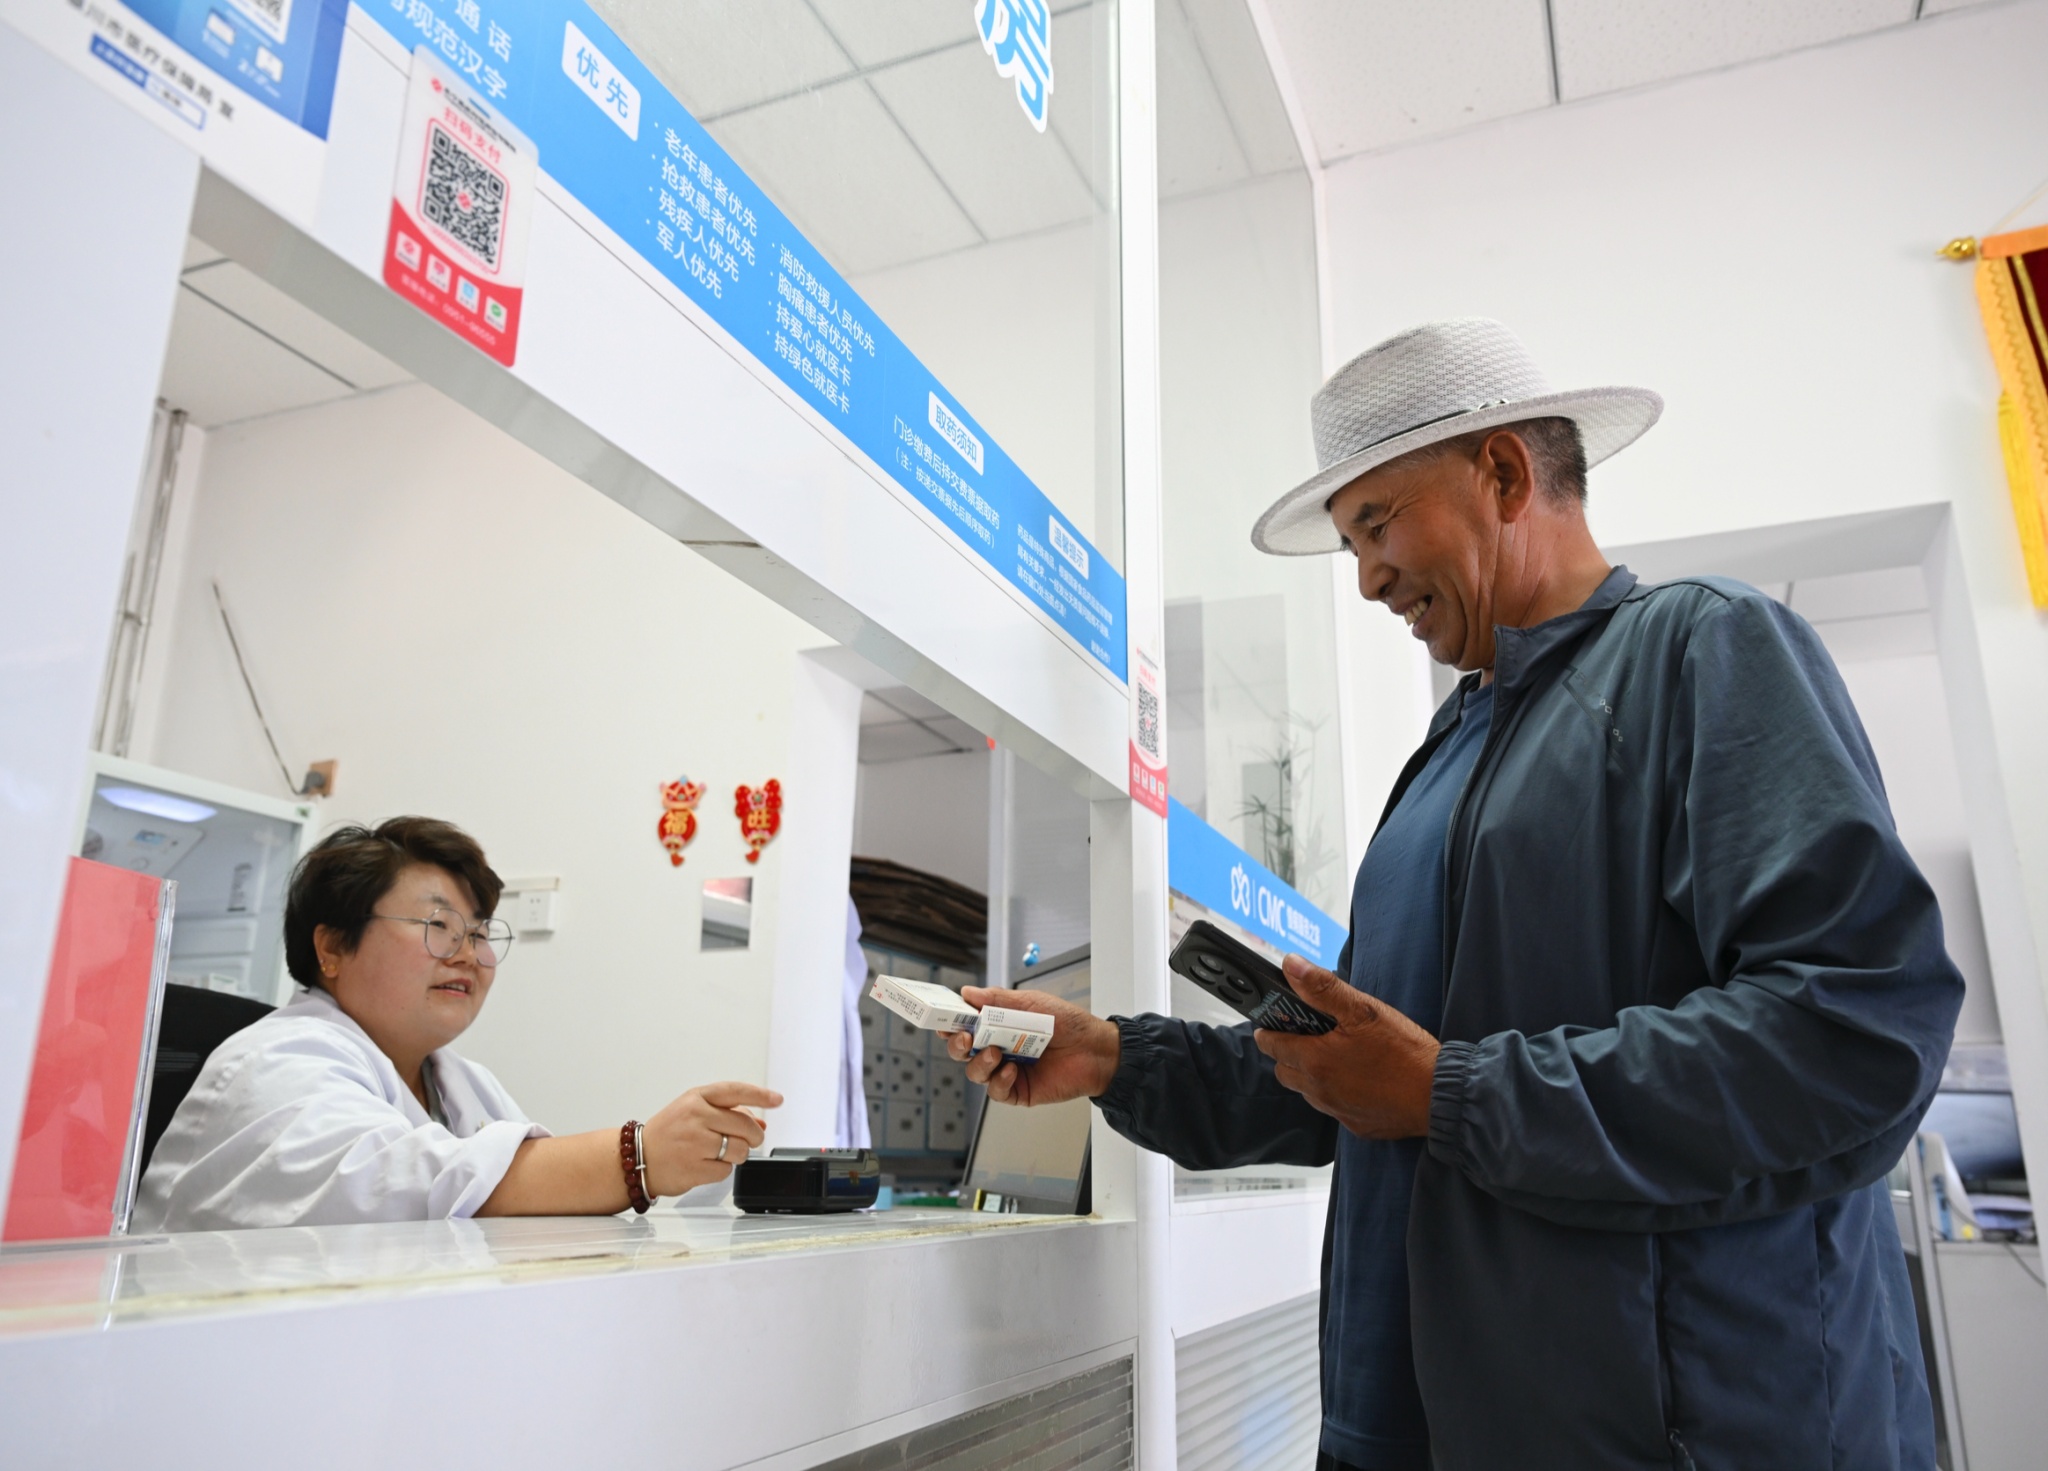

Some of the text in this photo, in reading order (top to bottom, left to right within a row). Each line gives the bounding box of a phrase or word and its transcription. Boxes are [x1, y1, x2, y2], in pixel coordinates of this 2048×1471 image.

[576, 45, 629, 118] 优先
[444, 107, 502, 164] 扫码支付
[661, 157, 757, 267] 抢救患者优先
[664, 127, 759, 236] 老年患者优先
[656, 222, 723, 299] 军人优先
[658, 188, 740, 283] 残疾人优先
[777, 273, 853, 363] 胸痛患者优先
[779, 243, 876, 358] 消防救援人员优先
[774, 331, 851, 416] 持绿色就医卡
[775, 302, 852, 388] 持爱心就医卡
[894, 414, 1000, 530] 门诊缴费后持交费票据取药
[936, 404, 977, 464] 取药须知
[1053, 525, 1085, 569] 温馨提示
[663, 810, 688, 835] 福
[747, 810, 771, 829] 旺
[1258, 885, 1286, 938] CMC
